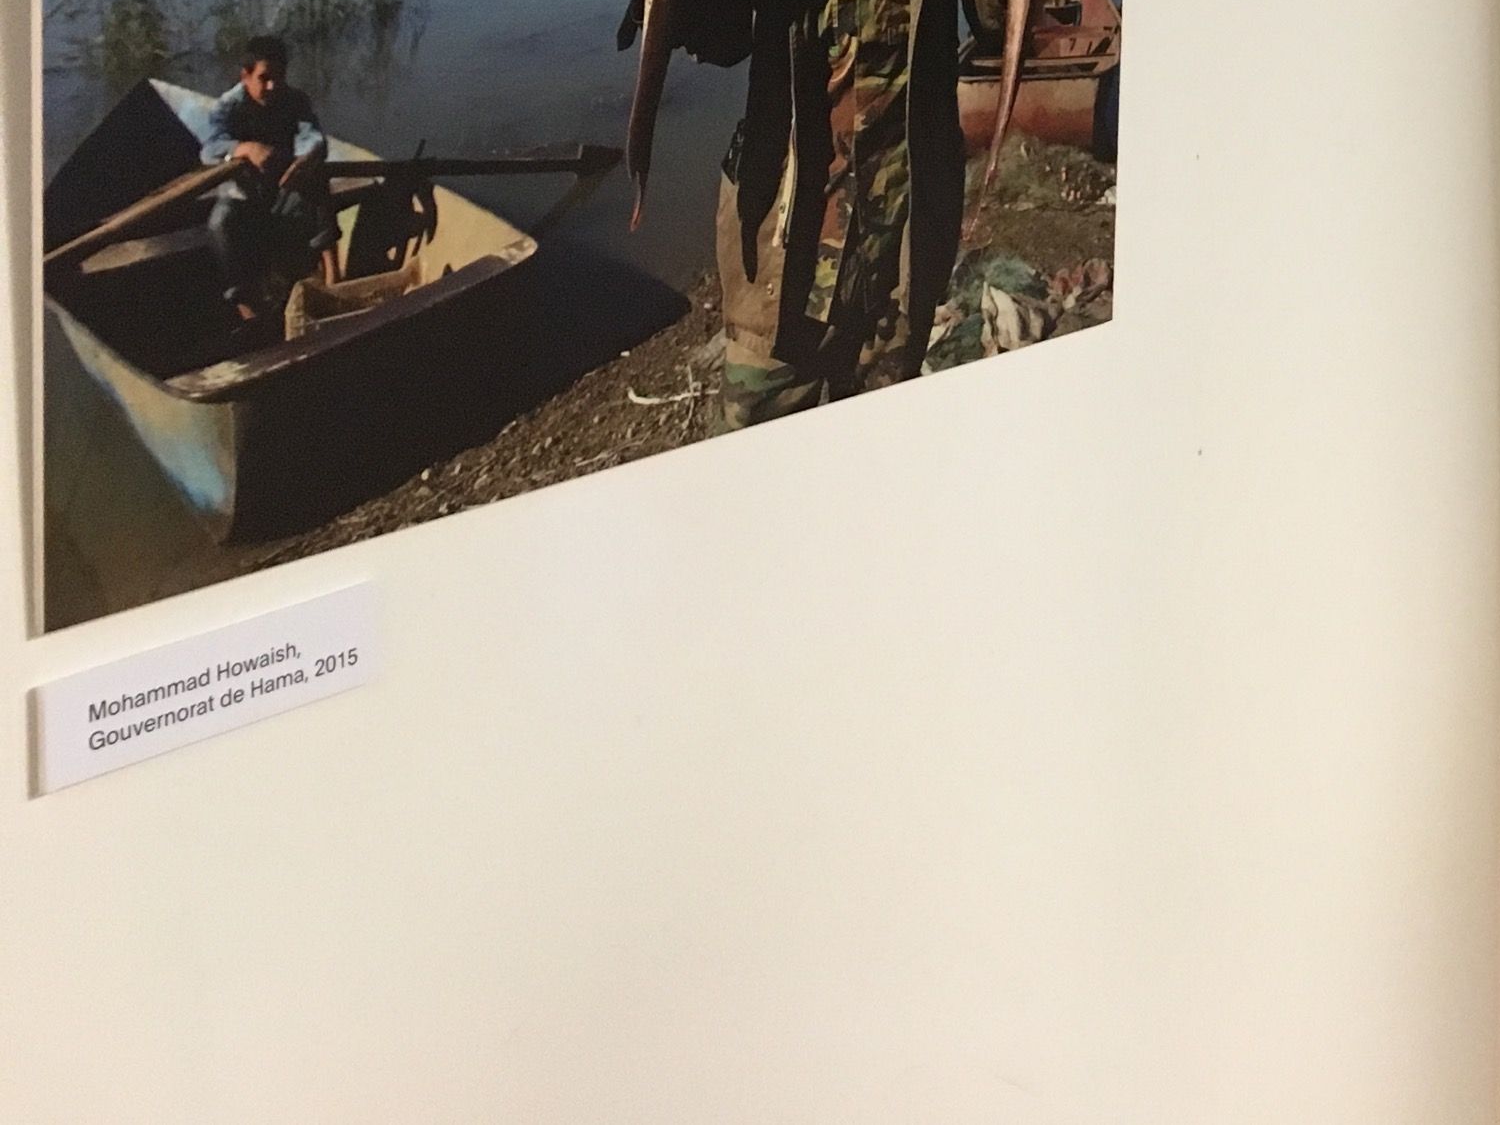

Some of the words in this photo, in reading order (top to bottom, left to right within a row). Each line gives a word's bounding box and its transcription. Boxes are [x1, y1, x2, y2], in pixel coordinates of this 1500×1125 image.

[88, 668, 210, 723] Mohammad
[217, 642, 301, 682] Howaish,
[88, 697, 215, 751] Gouvernorat
[220, 688, 245, 708] de
[251, 669, 309, 698] Hama,
[315, 648, 358, 677] 2015
